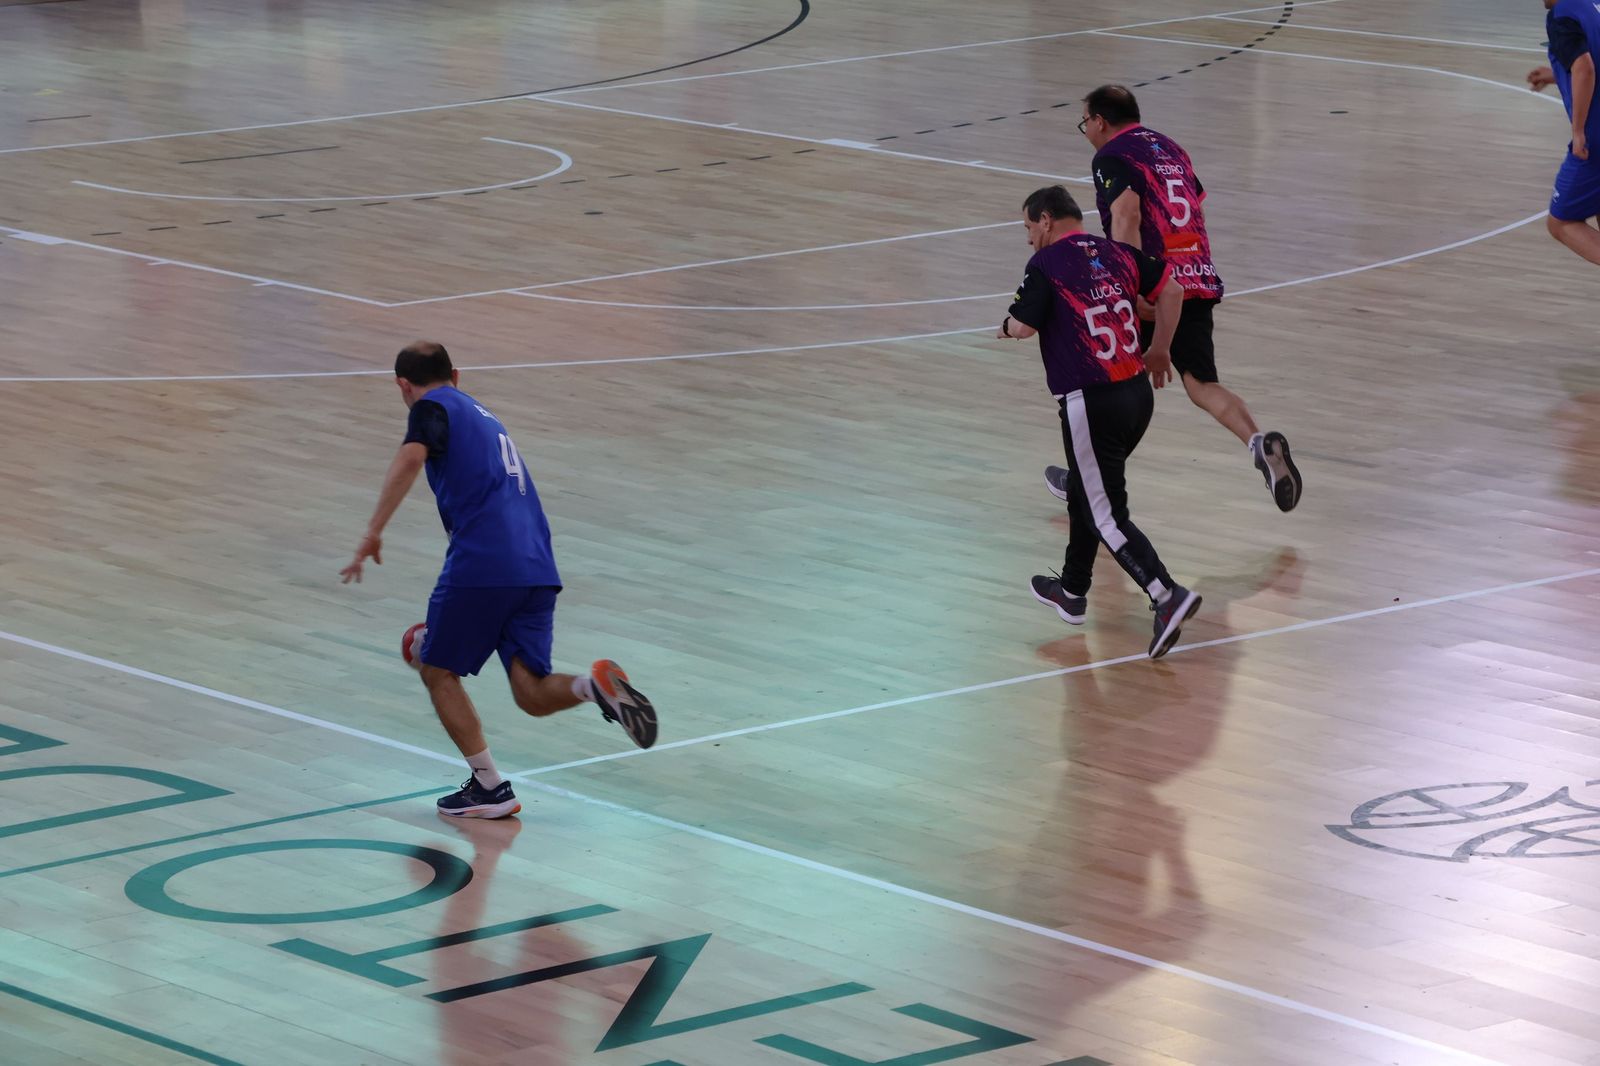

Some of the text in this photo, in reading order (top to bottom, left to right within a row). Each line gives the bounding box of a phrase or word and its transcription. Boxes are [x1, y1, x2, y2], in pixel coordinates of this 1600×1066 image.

[1155, 164, 1184, 175] PEDRO
[1165, 178, 1191, 227] 5
[1090, 283, 1123, 300] LUCAS
[1083, 300, 1139, 360] 53
[498, 433, 526, 496] 4
